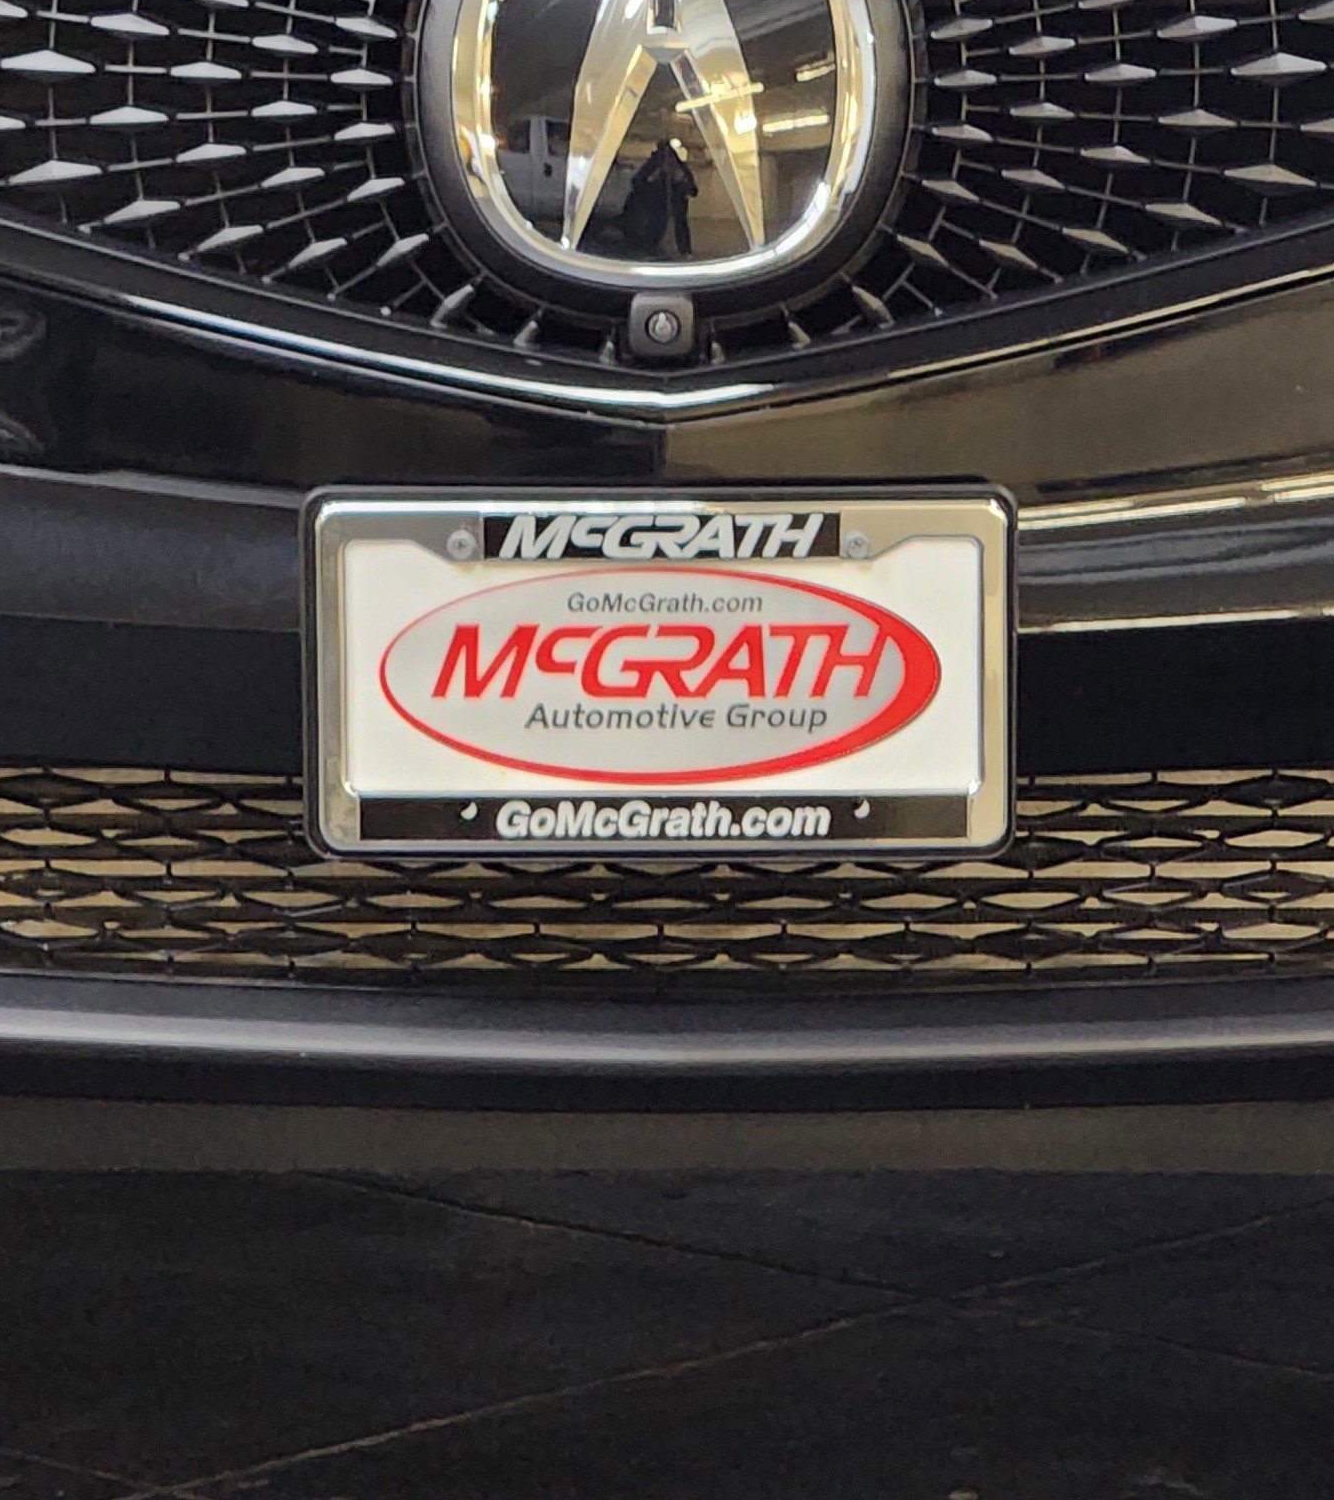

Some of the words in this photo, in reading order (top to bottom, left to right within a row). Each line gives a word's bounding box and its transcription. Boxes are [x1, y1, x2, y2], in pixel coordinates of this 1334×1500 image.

[567, 591, 763, 614] GoMcGrath.com
[525, 703, 716, 731] Automotive
[726, 703, 828, 734] Group
[495, 800, 831, 838] GoMcGrath.com
